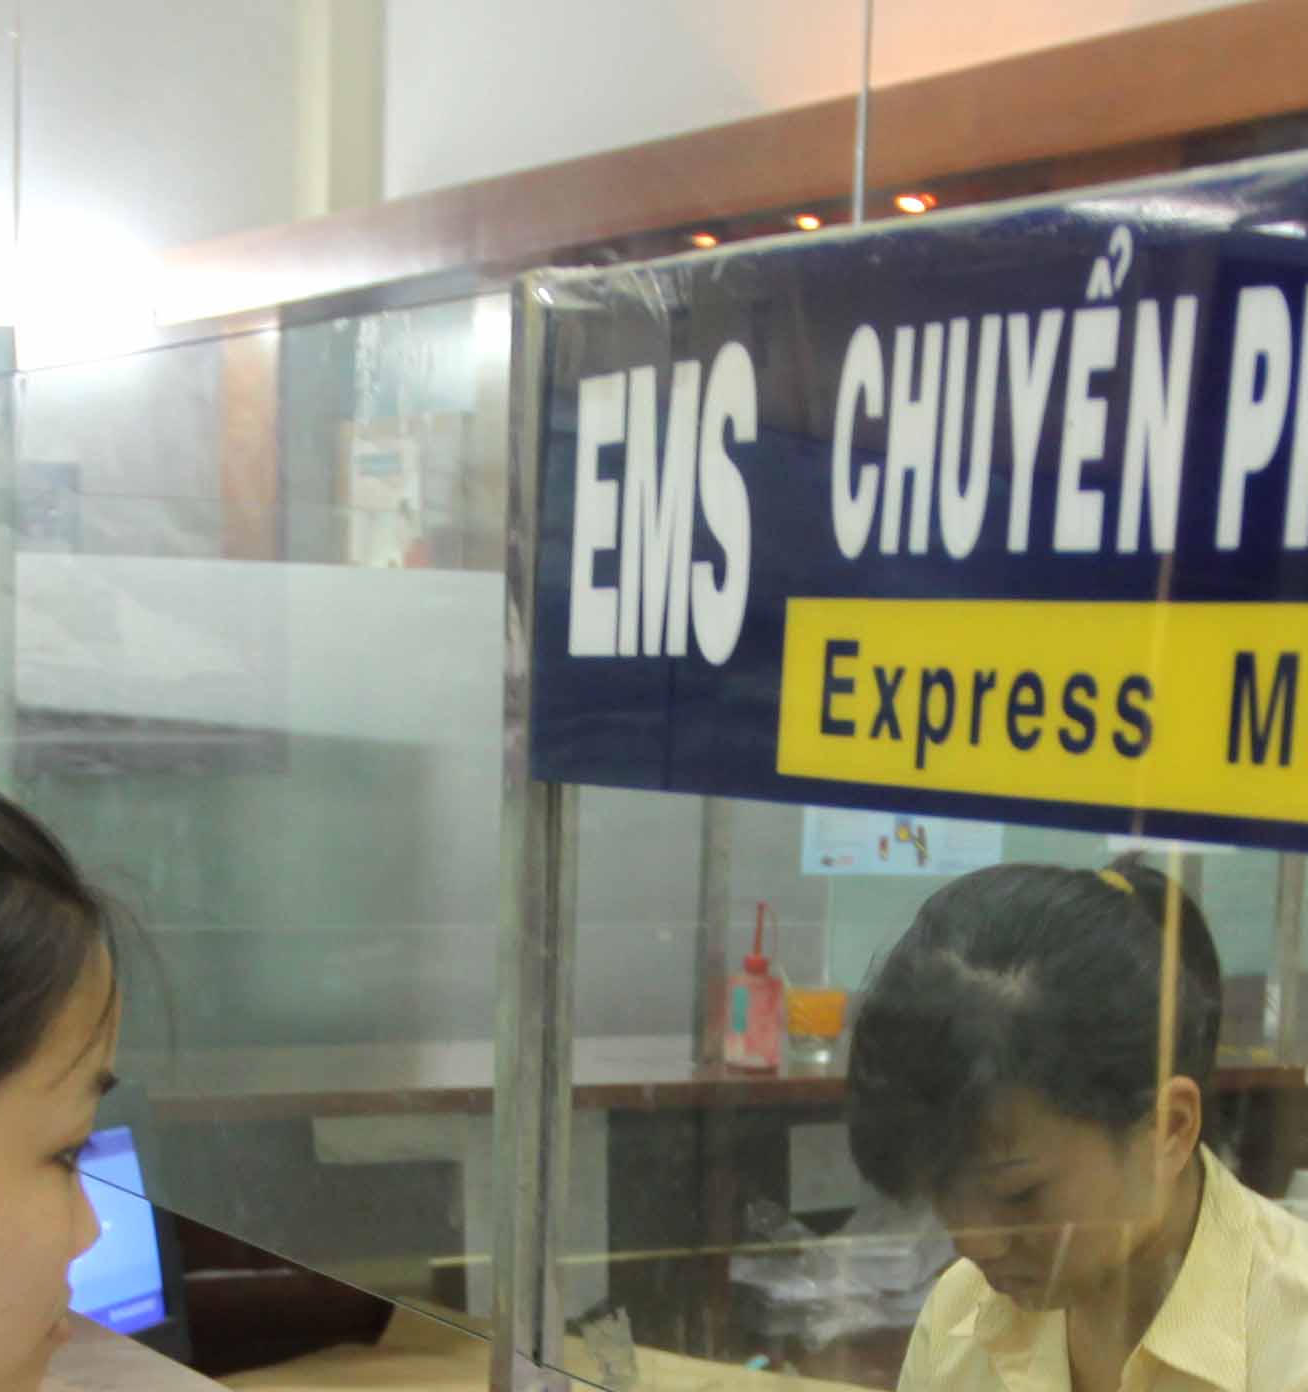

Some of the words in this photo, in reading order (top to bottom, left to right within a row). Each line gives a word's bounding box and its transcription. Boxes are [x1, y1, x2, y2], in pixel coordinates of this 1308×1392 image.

[568, 341, 758, 666] EMS
[830, 226, 1199, 560] CHUYỂN
[818, 638, 1156, 770] Express
